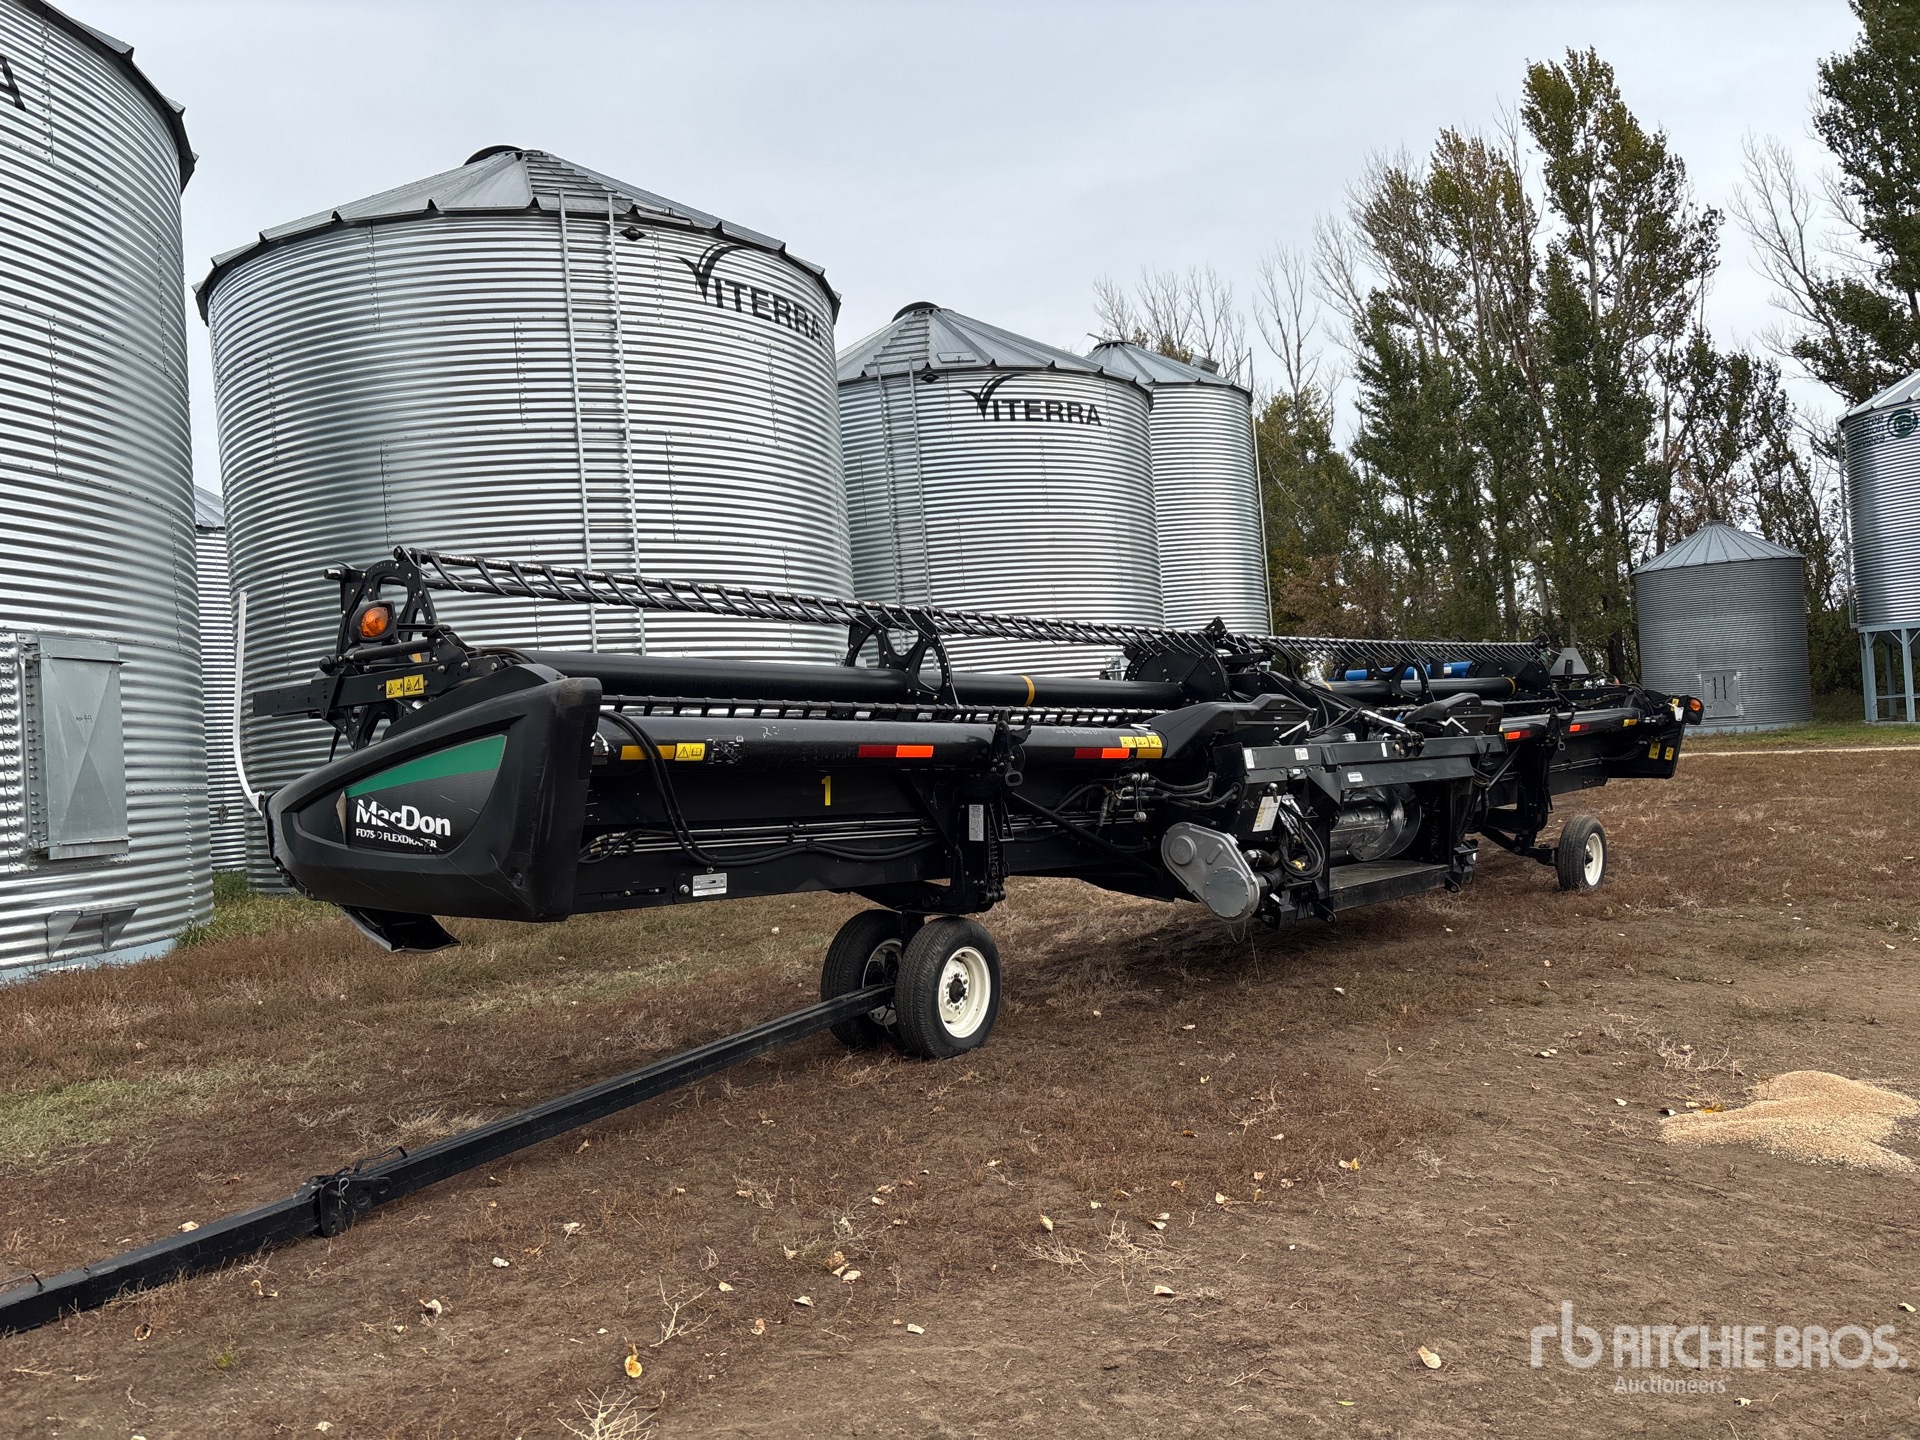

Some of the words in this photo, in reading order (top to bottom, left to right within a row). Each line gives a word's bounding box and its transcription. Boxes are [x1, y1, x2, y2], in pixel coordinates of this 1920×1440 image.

[673, 241, 823, 347] VITERRA
[960, 373, 1102, 426] VITERRA
[821, 775, 832, 807] 1
[356, 799, 451, 837] MacDon
